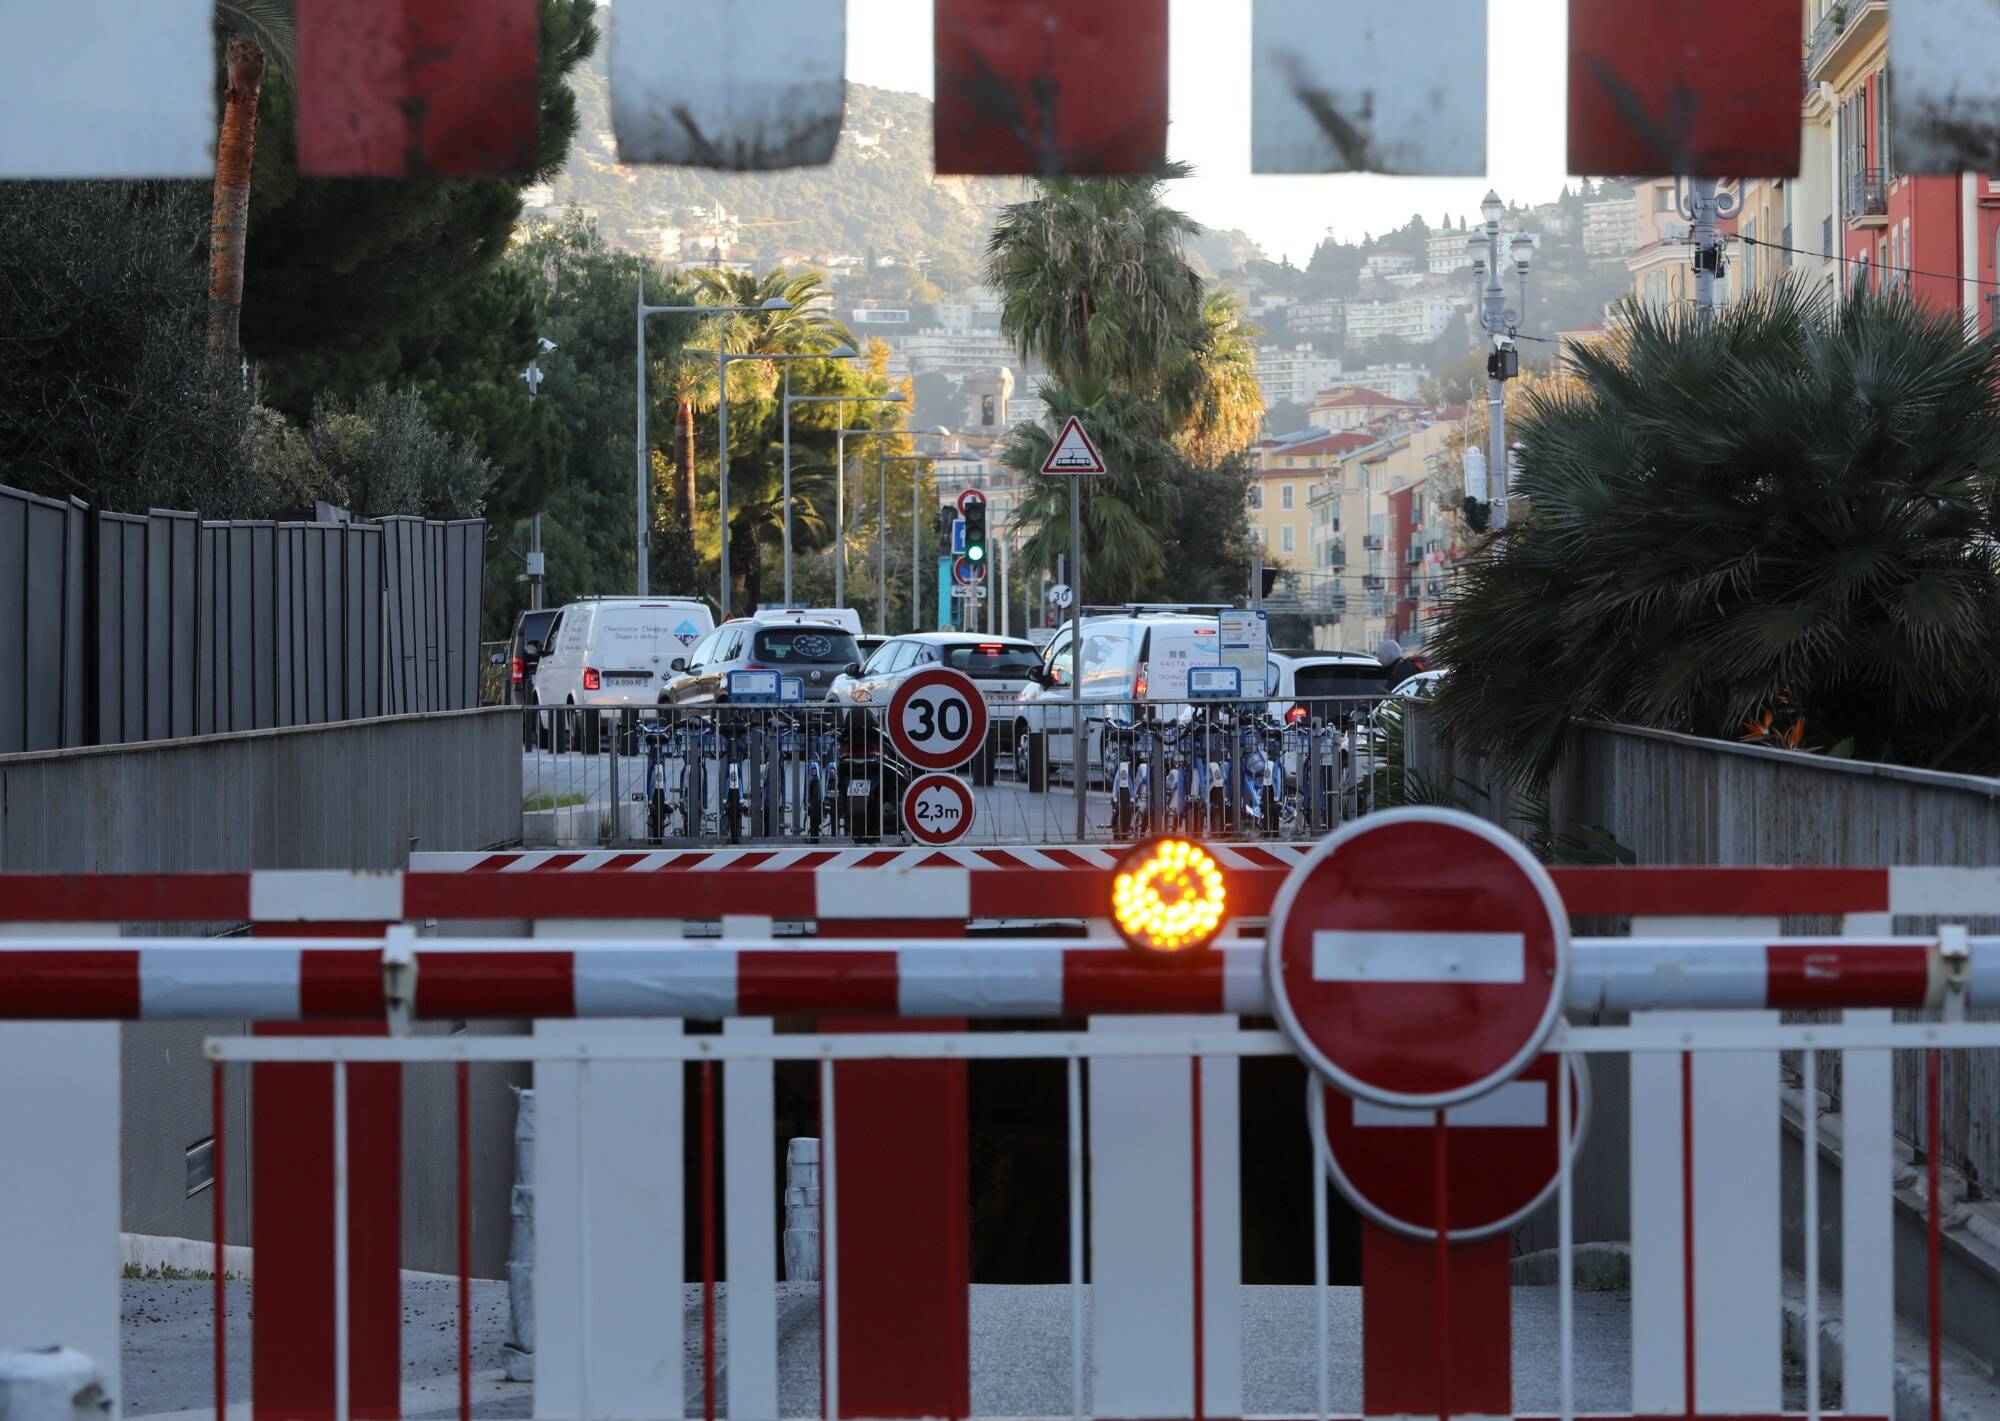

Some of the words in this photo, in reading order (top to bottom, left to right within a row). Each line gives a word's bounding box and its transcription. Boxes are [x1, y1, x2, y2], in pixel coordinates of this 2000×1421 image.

[1054, 591, 1068, 602] 30
[907, 698, 968, 741] 30
[917, 801, 959, 822] 2,3m
